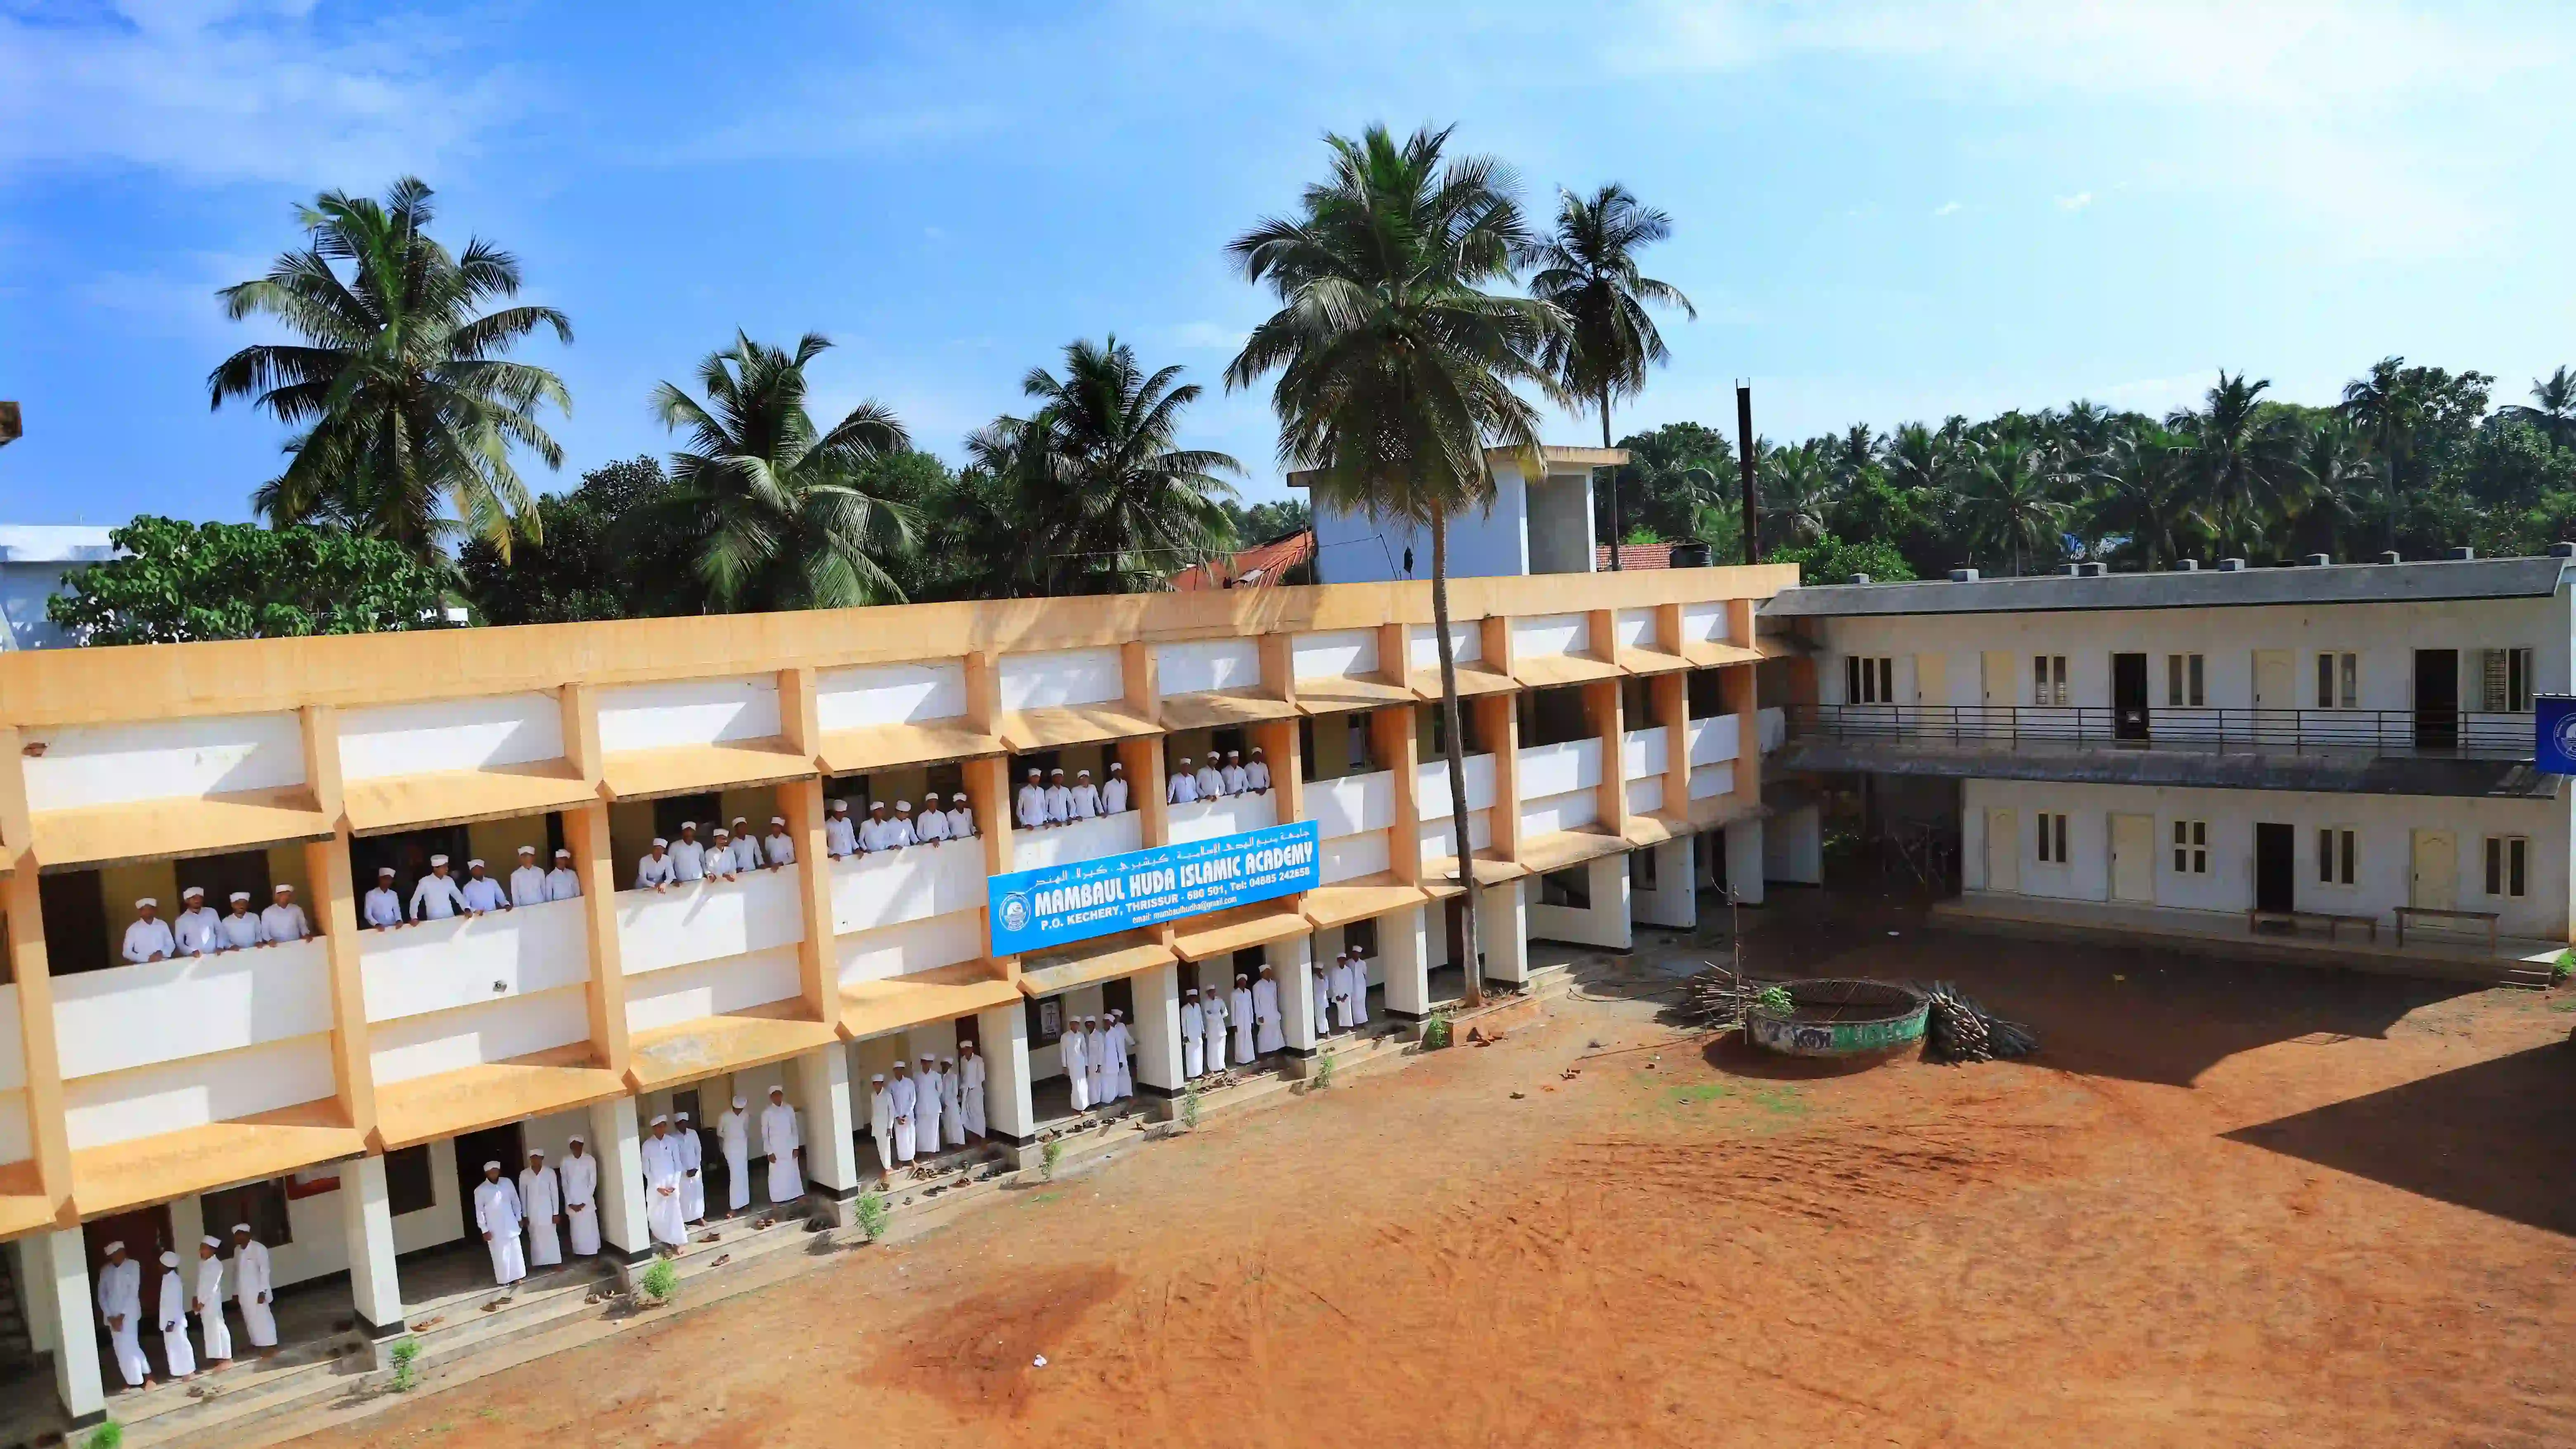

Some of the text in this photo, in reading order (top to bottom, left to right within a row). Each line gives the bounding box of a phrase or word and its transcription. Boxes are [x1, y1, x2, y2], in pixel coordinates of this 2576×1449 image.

[1035, 878, 1125, 917] MAMBAUL
[1129, 867, 1176, 897] HUDA
[1180, 856, 1241, 888] ISLAMIC
[1245, 841, 1312, 875] ACADEMY
[1041, 918, 1064, 930] P.O.
[1067, 905, 1123, 925] KECHERY,
[1125, 893, 1179, 913] THRISSUR
[1187, 889, 1204, 900] 680
[1208, 885, 1227, 896] 501,
[1230, 881, 1247, 891] Tel:
[1132, 913, 1151, 923] email:
